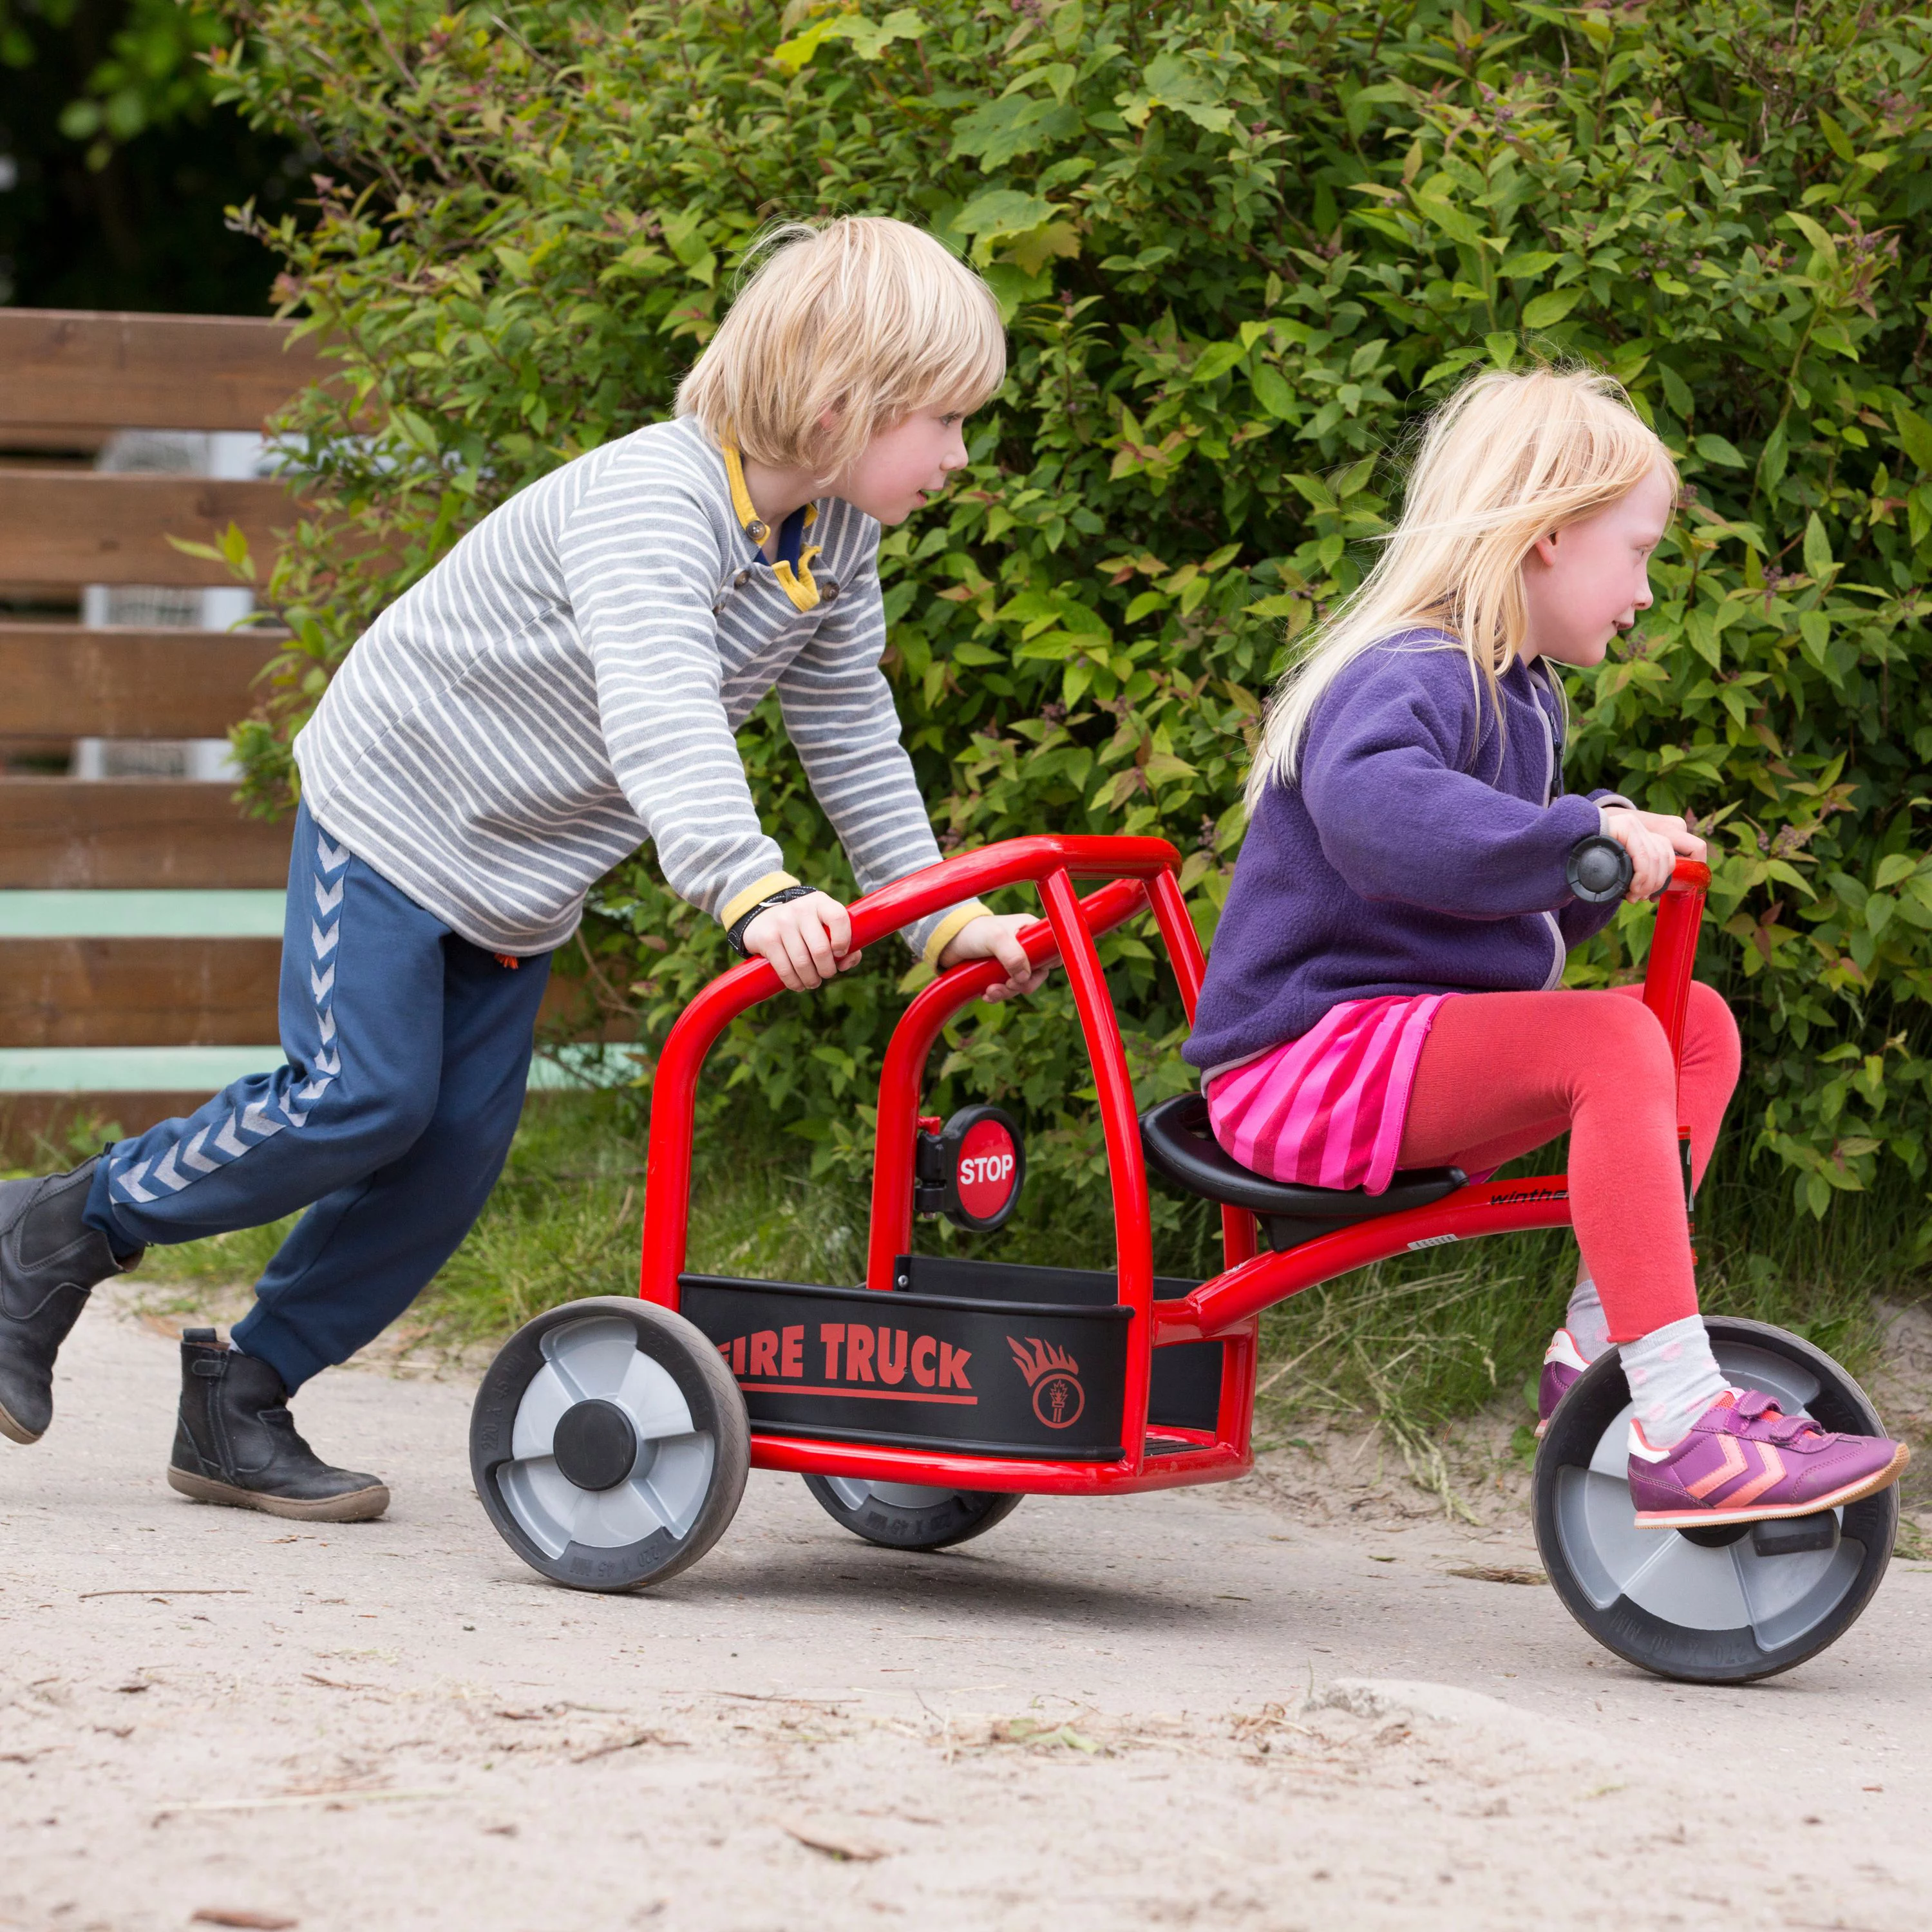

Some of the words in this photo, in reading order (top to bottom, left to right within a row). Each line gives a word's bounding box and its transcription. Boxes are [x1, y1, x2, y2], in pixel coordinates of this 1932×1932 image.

[960, 1154, 1013, 1185] STOP
[1490, 1189, 1569, 1206] winthe
[820, 1323, 972, 1389] TRUCK
